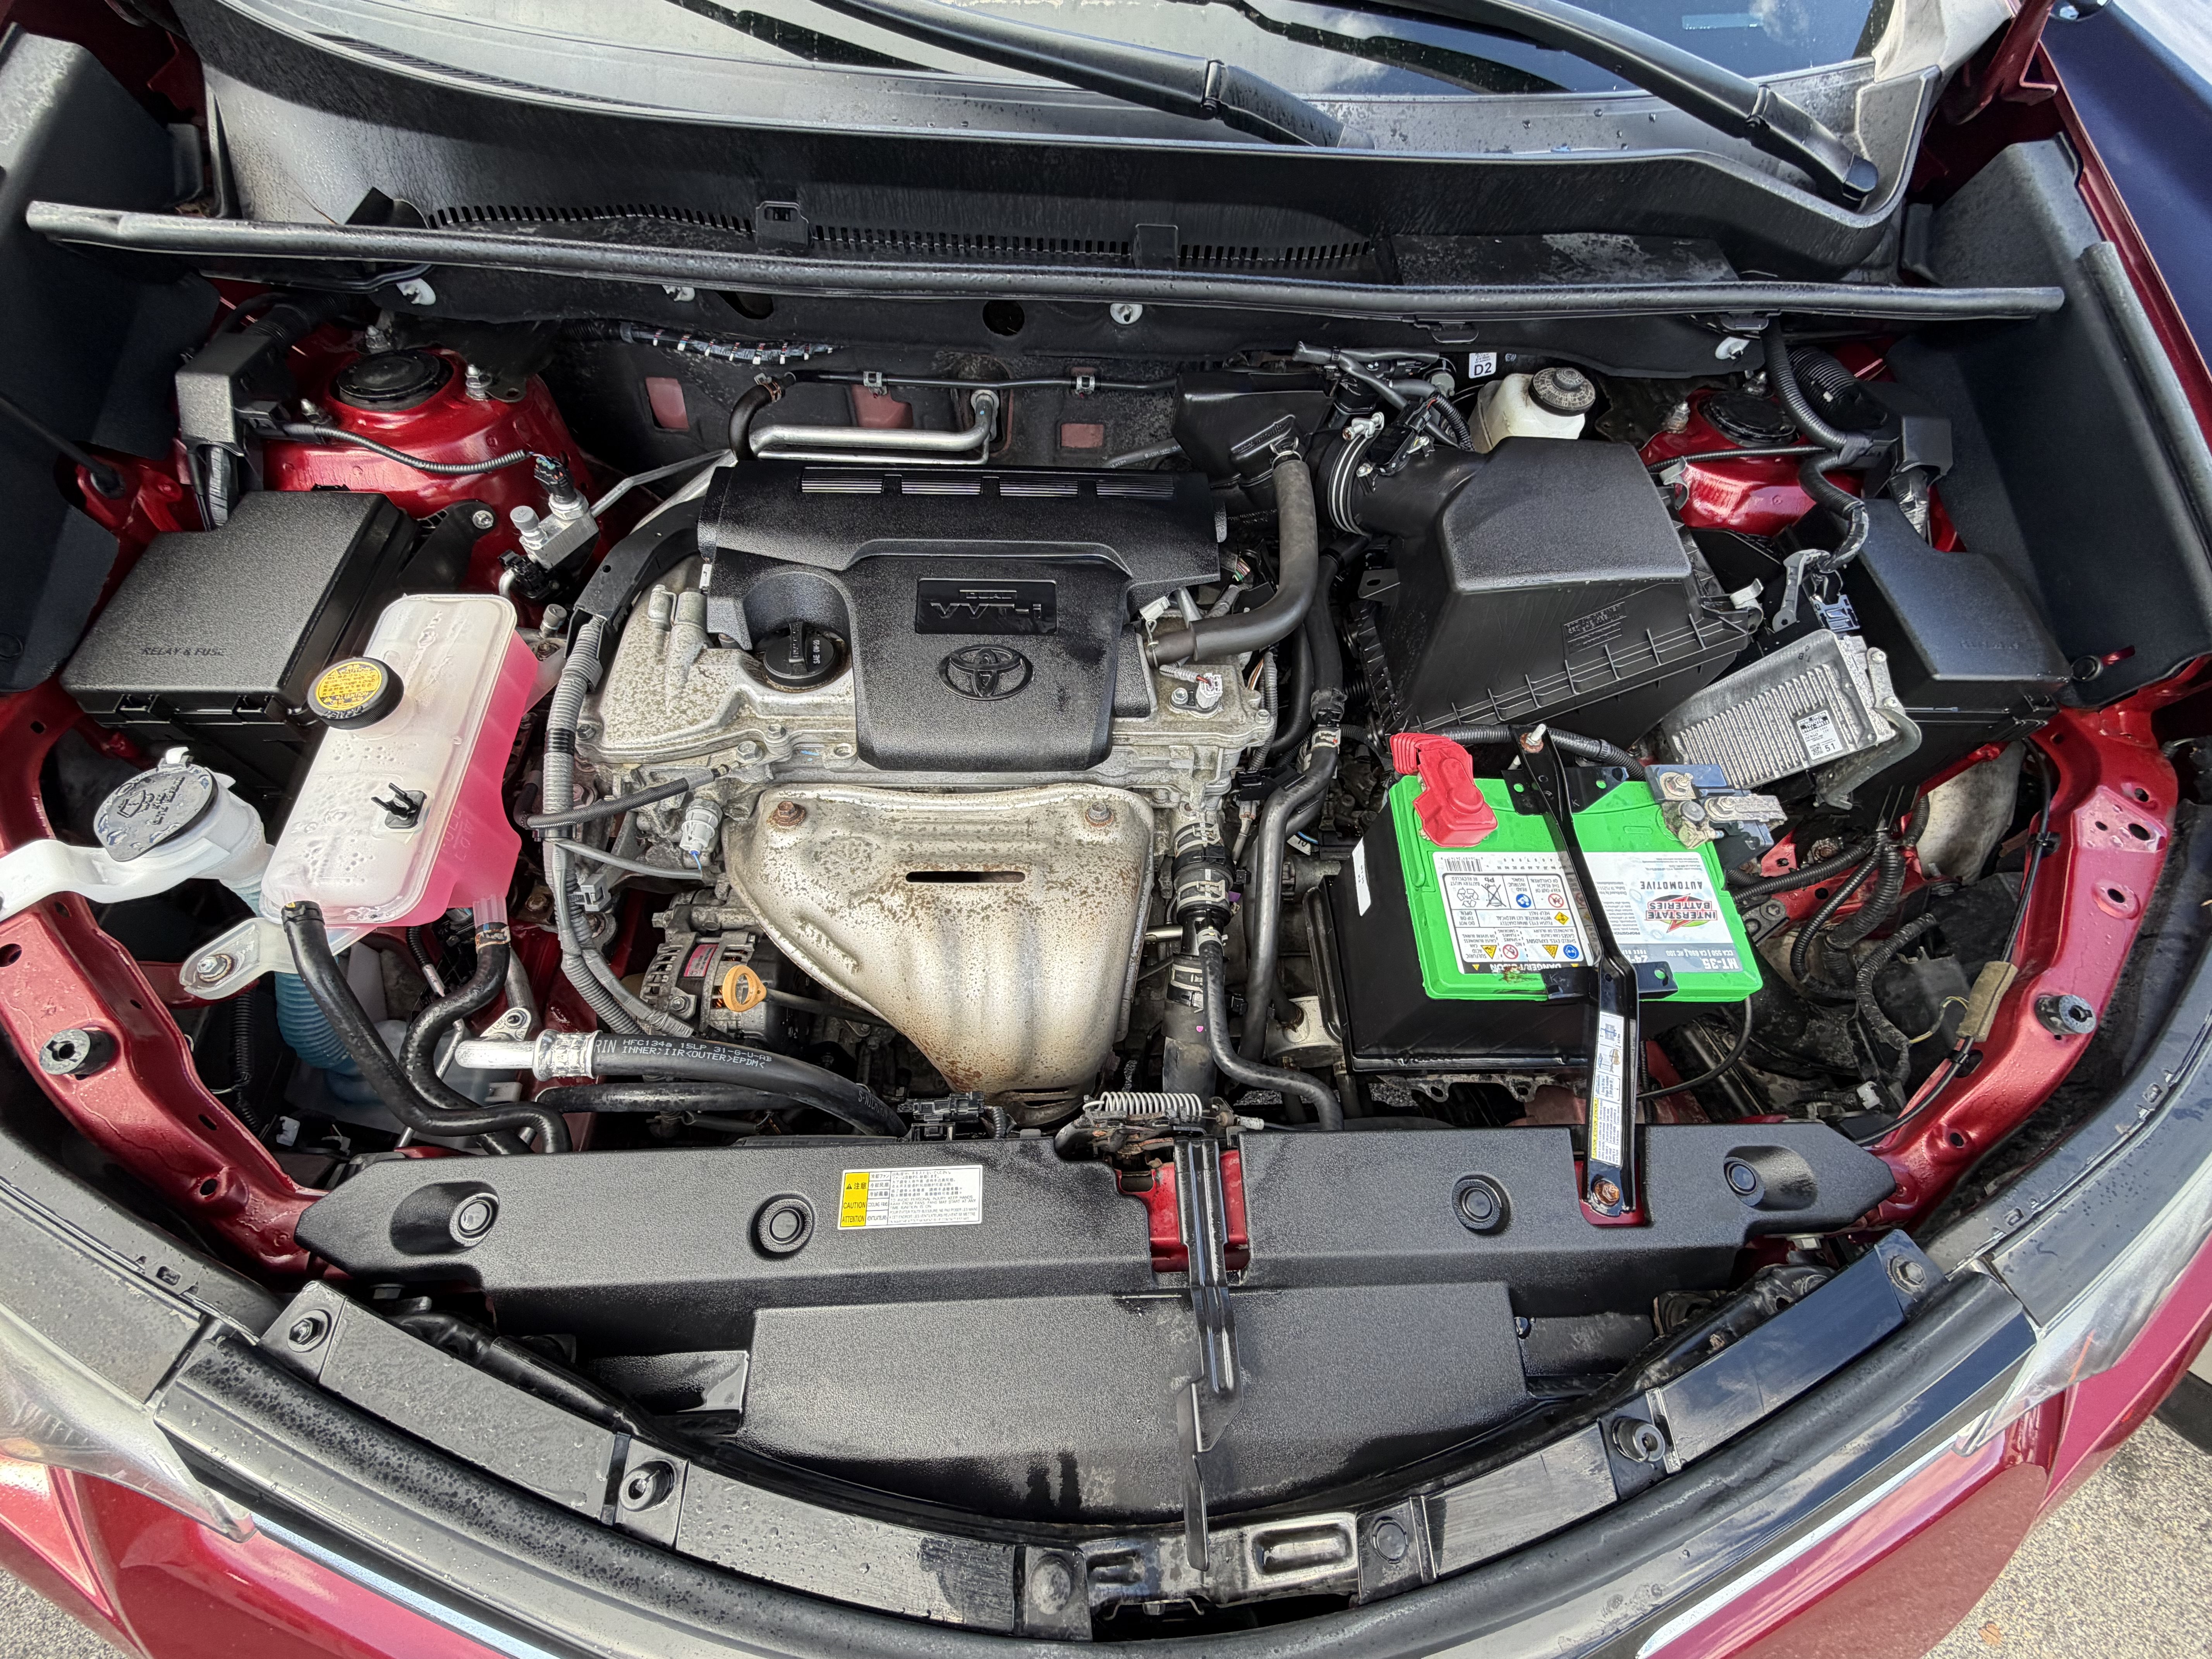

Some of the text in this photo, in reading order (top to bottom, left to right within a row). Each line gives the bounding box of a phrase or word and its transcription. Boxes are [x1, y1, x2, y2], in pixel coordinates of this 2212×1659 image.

[1474, 362, 1492, 376] D2
[930, 603, 1042, 620] VVT-i
[812, 654, 821, 664] SAE
[1824, 743, 1836, 752] 51
[1640, 881, 1702, 890] AUTOMOTIVE
[1647, 911, 1716, 919] INTERSTATE
[1702, 958, 1739, 969] MT-35
[622, 1039, 673, 1048] HFC134a
[680, 1042, 707, 1051] 15LP
